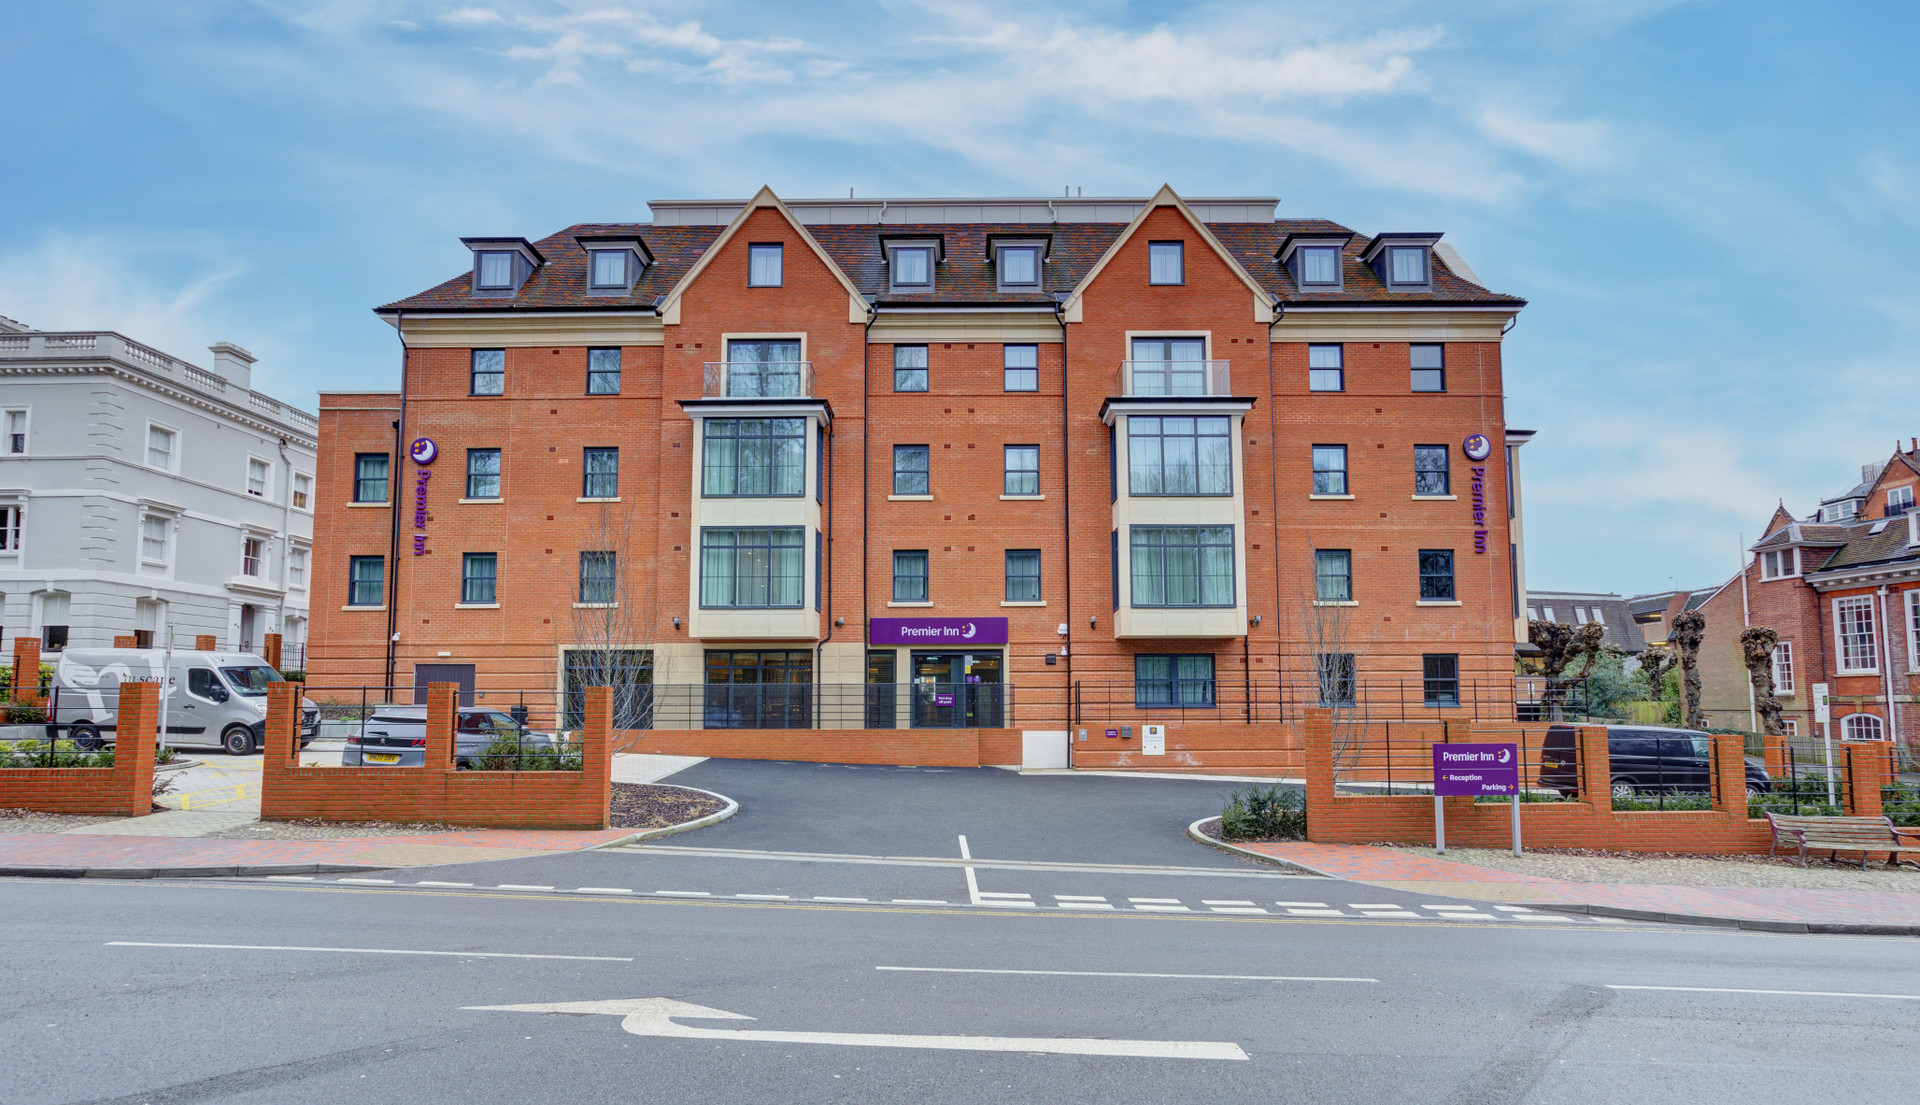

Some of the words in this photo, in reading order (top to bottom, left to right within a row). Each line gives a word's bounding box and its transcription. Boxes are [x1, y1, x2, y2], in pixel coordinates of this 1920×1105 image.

[414, 469, 431, 531] Premier
[1471, 466, 1487, 527] Premier
[413, 534, 428, 556] Inn
[1474, 530, 1488, 554] Inn
[901, 626, 942, 636] Premier
[943, 626, 960, 636] Inn
[1443, 751, 1479, 762] Premier
[1480, 751, 1495, 762] Inn
[1449, 774, 1483, 782] Reception
[1481, 783, 1507, 792] Parking
